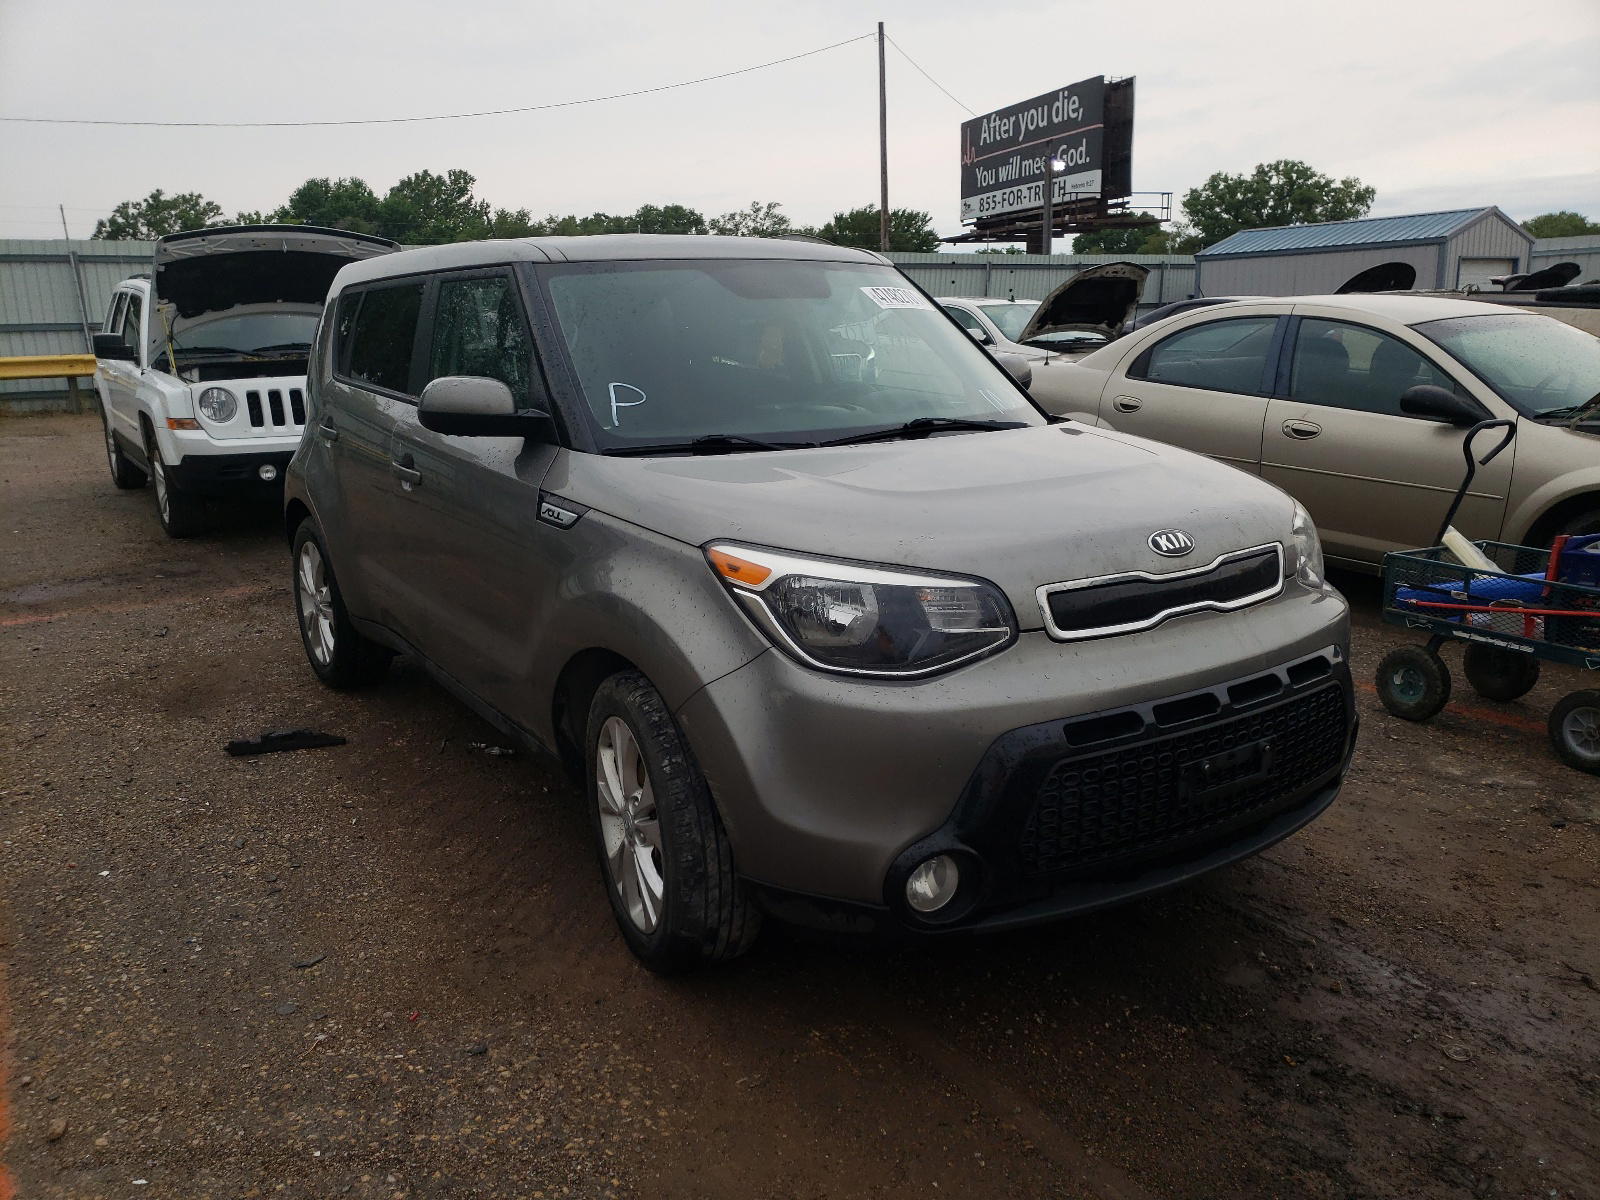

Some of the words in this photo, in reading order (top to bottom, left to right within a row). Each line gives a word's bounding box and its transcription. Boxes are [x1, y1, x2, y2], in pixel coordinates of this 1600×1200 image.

[980, 114, 1015, 146] After
[1018, 104, 1048, 142] you
[1051, 91, 1083, 123] die,
[976, 166, 996, 188] You
[999, 155, 1020, 182] will
[1022, 155, 1049, 177] mee
[1057, 138, 1090, 168] God.
[979, 179, 1066, 212] 855-FOR-TRTH
[608, 382, 647, 427] P
[1154, 532, 1192, 551] KIA
